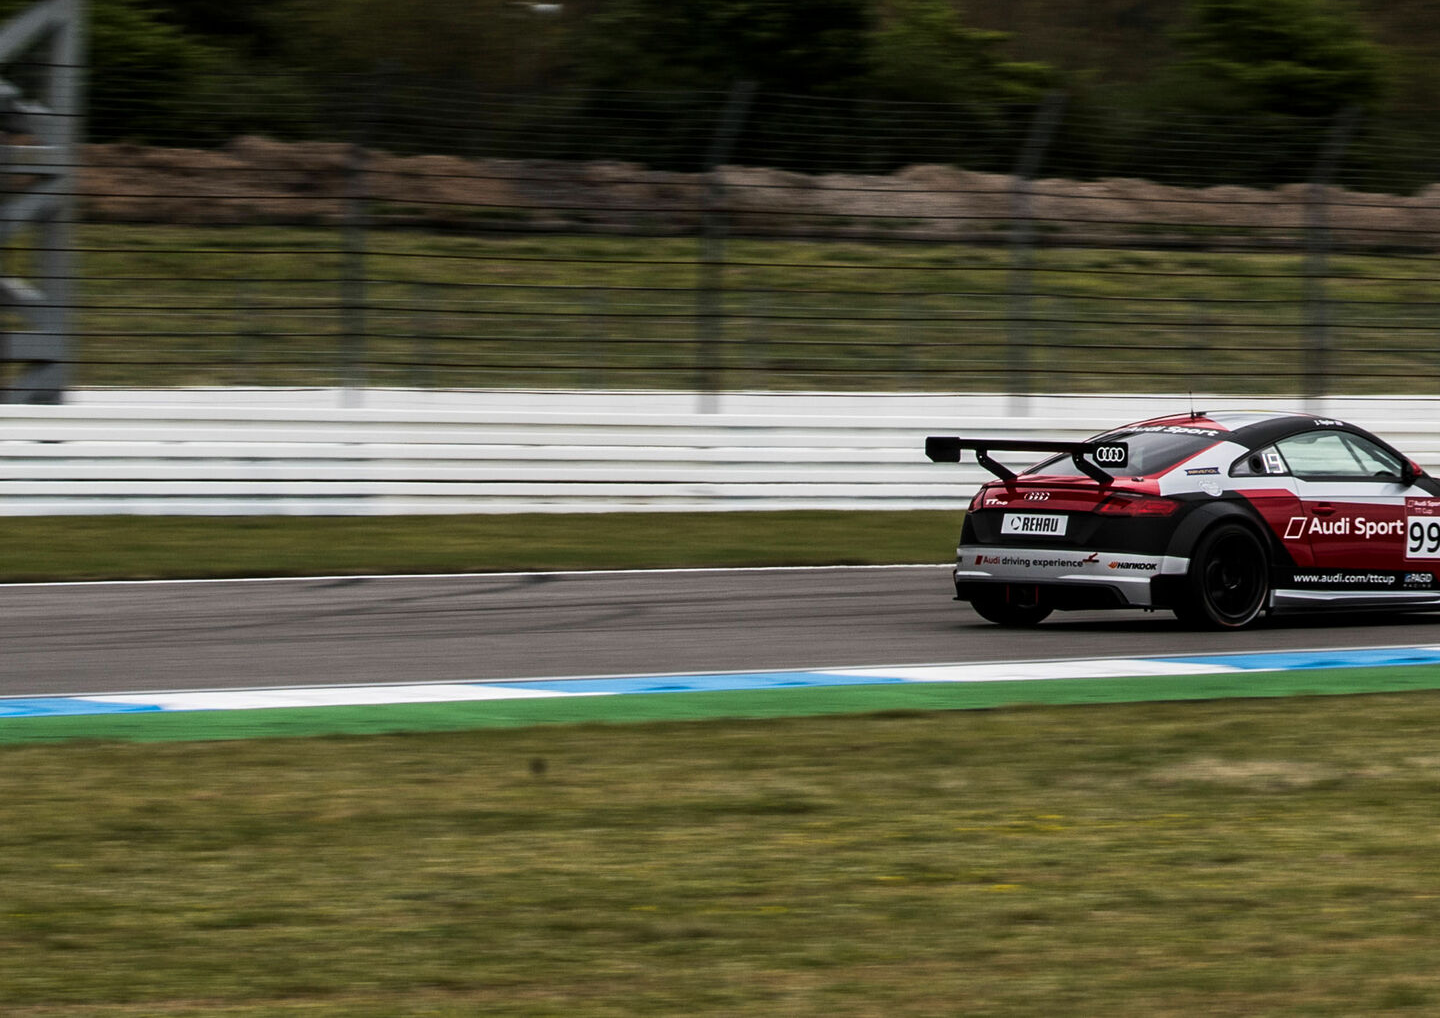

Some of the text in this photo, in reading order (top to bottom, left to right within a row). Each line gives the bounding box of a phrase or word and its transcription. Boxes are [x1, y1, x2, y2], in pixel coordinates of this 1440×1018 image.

[1164, 426, 1219, 436] Sport
[1261, 452, 1284, 474] 19
[1021, 516, 1059, 533] REHAU
[1308, 517, 1404, 540] Audi Sport
[983, 555, 1084, 569] Audi driving experience
[1293, 572, 1396, 586] www.audi.com/ttcup
